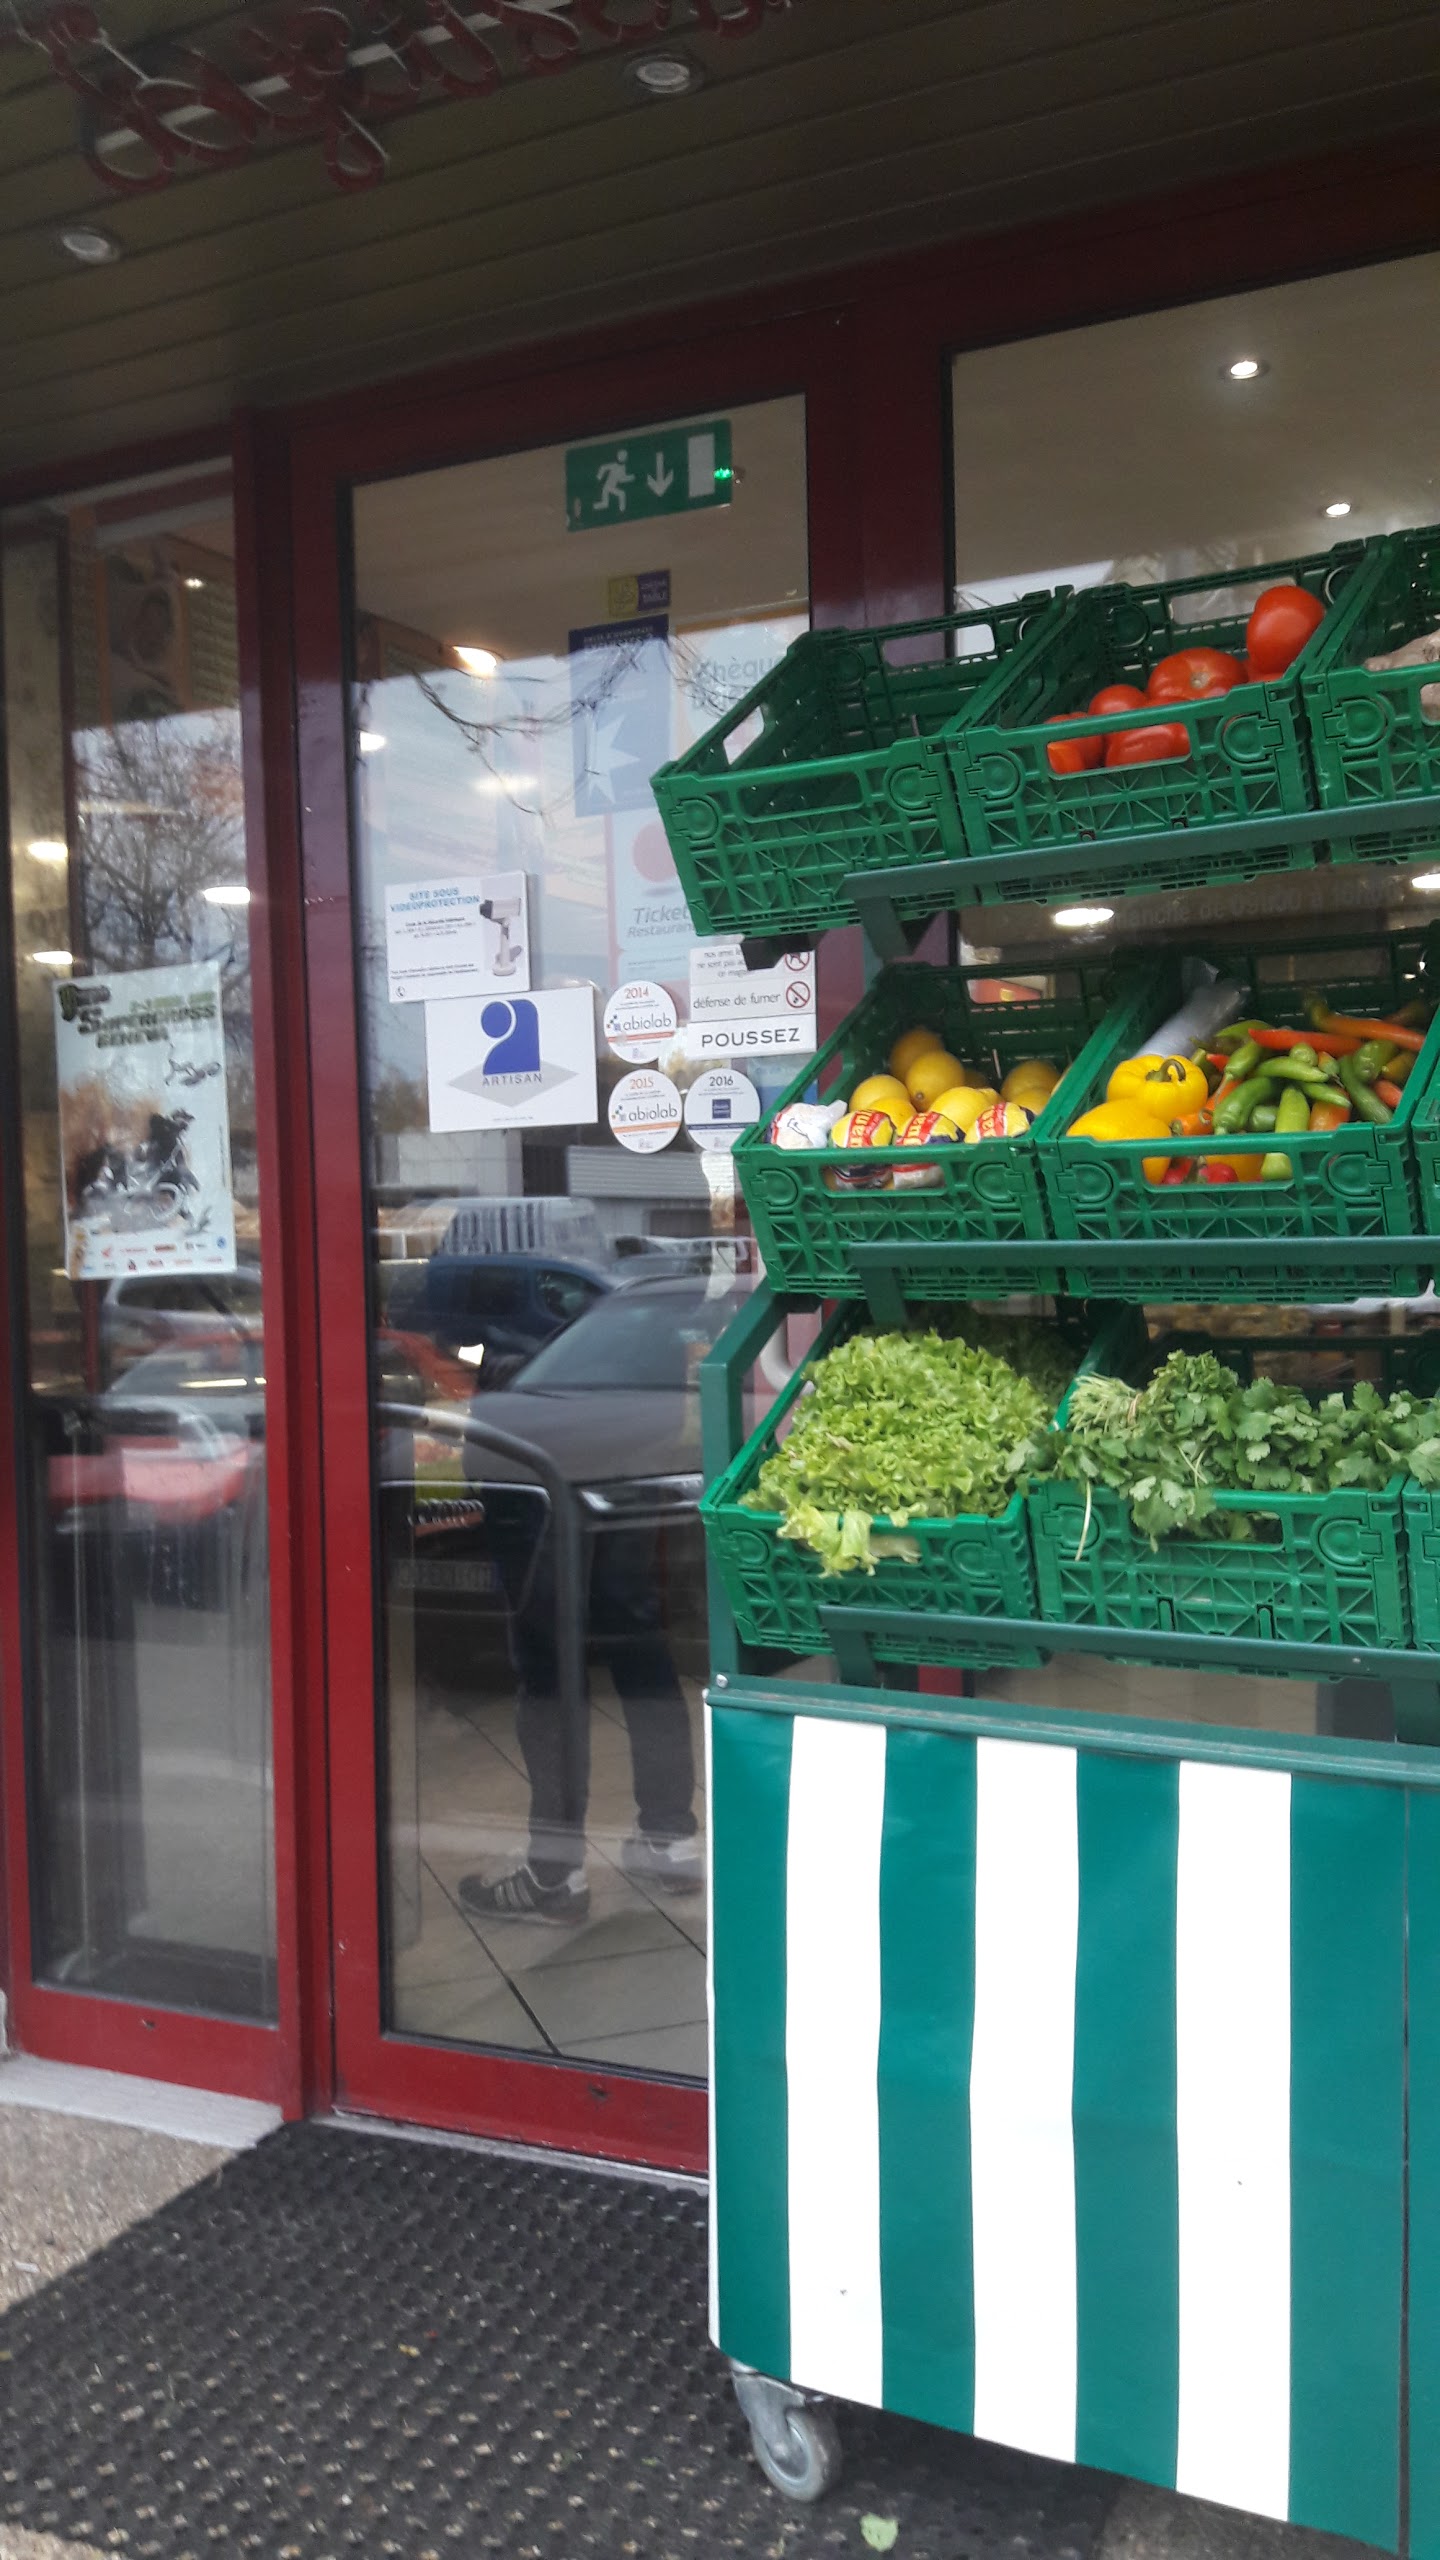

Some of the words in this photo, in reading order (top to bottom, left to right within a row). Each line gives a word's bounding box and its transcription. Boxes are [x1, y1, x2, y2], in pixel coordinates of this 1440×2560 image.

[409, 889, 430, 901] SITE
[432, 887, 459, 898] SOUS
[626, 922, 694, 938] Restauran
[625, 986, 649, 999] 2014
[734, 995, 747, 1006] de
[750, 992, 780, 1004] fumer
[622, 1012, 672, 1032] abiolab
[702, 1027, 801, 1048] POUSSEZ
[482, 1073, 542, 1087] ARTISAN
[630, 1077, 654, 1090] 2015
[709, 1076, 734, 1087] 2016
[628, 1103, 678, 1122] abiolab
